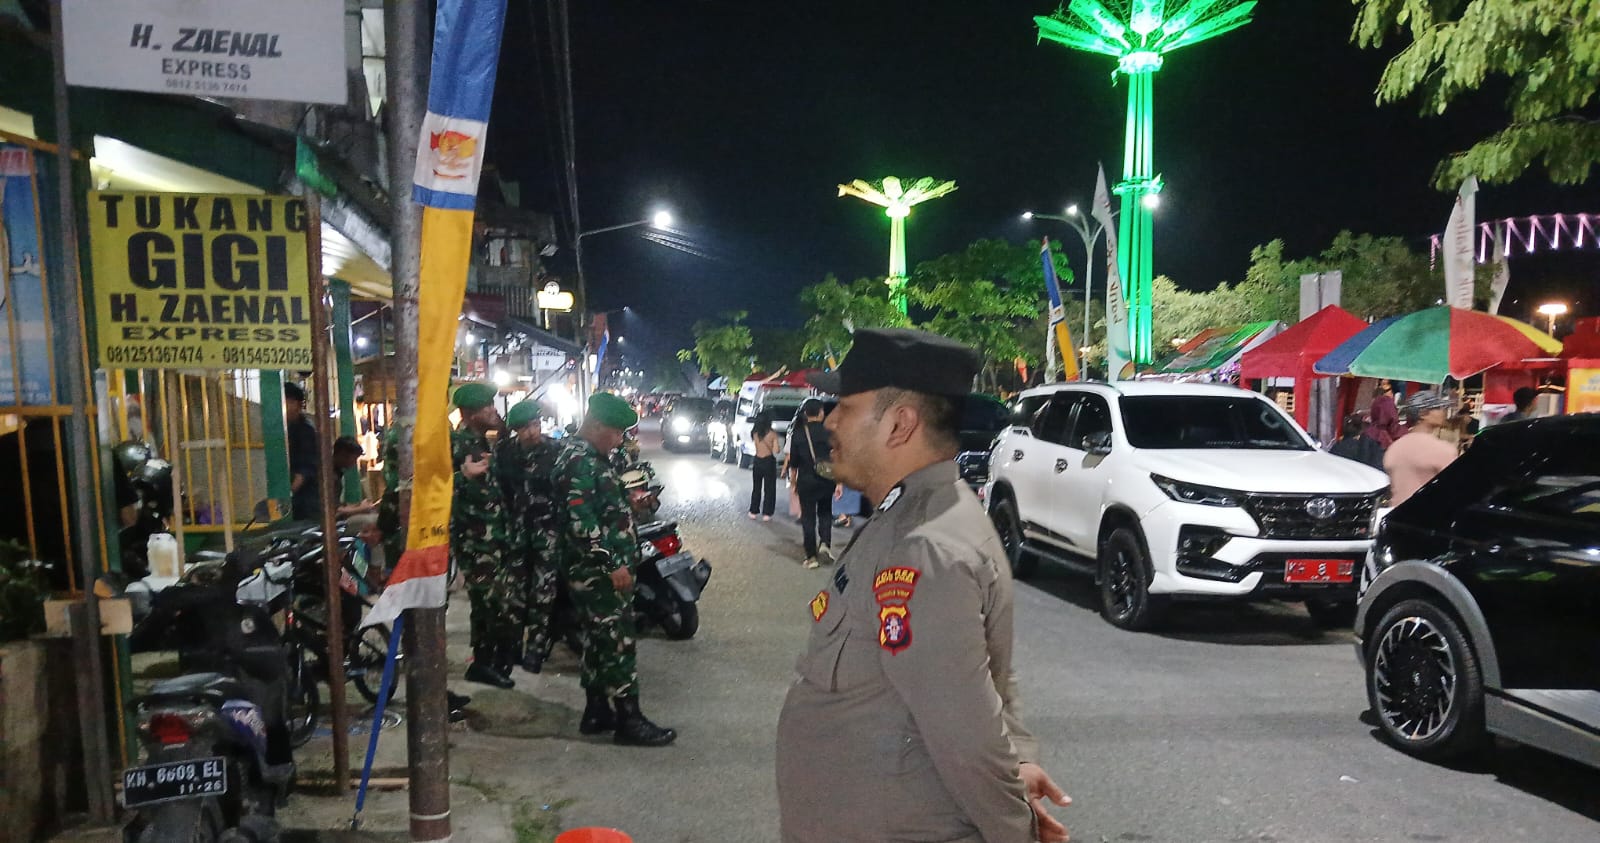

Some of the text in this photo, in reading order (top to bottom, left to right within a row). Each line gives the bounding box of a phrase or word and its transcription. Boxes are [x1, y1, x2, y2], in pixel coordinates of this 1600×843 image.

[130, 23, 282, 58] H. ZAENAL
[162, 58, 251, 80] EXPRESS
[98, 195, 307, 232] TUKANG
[127, 231, 288, 291] GIGI
[110, 293, 310, 325] H. ZAENAL
[121, 326, 301, 341] EXPRESS
[107, 346, 204, 363] 081251367474
[222, 346, 312, 365] 08154532056
[126, 770, 147, 788] KH
[203, 760, 222, 778] EL
